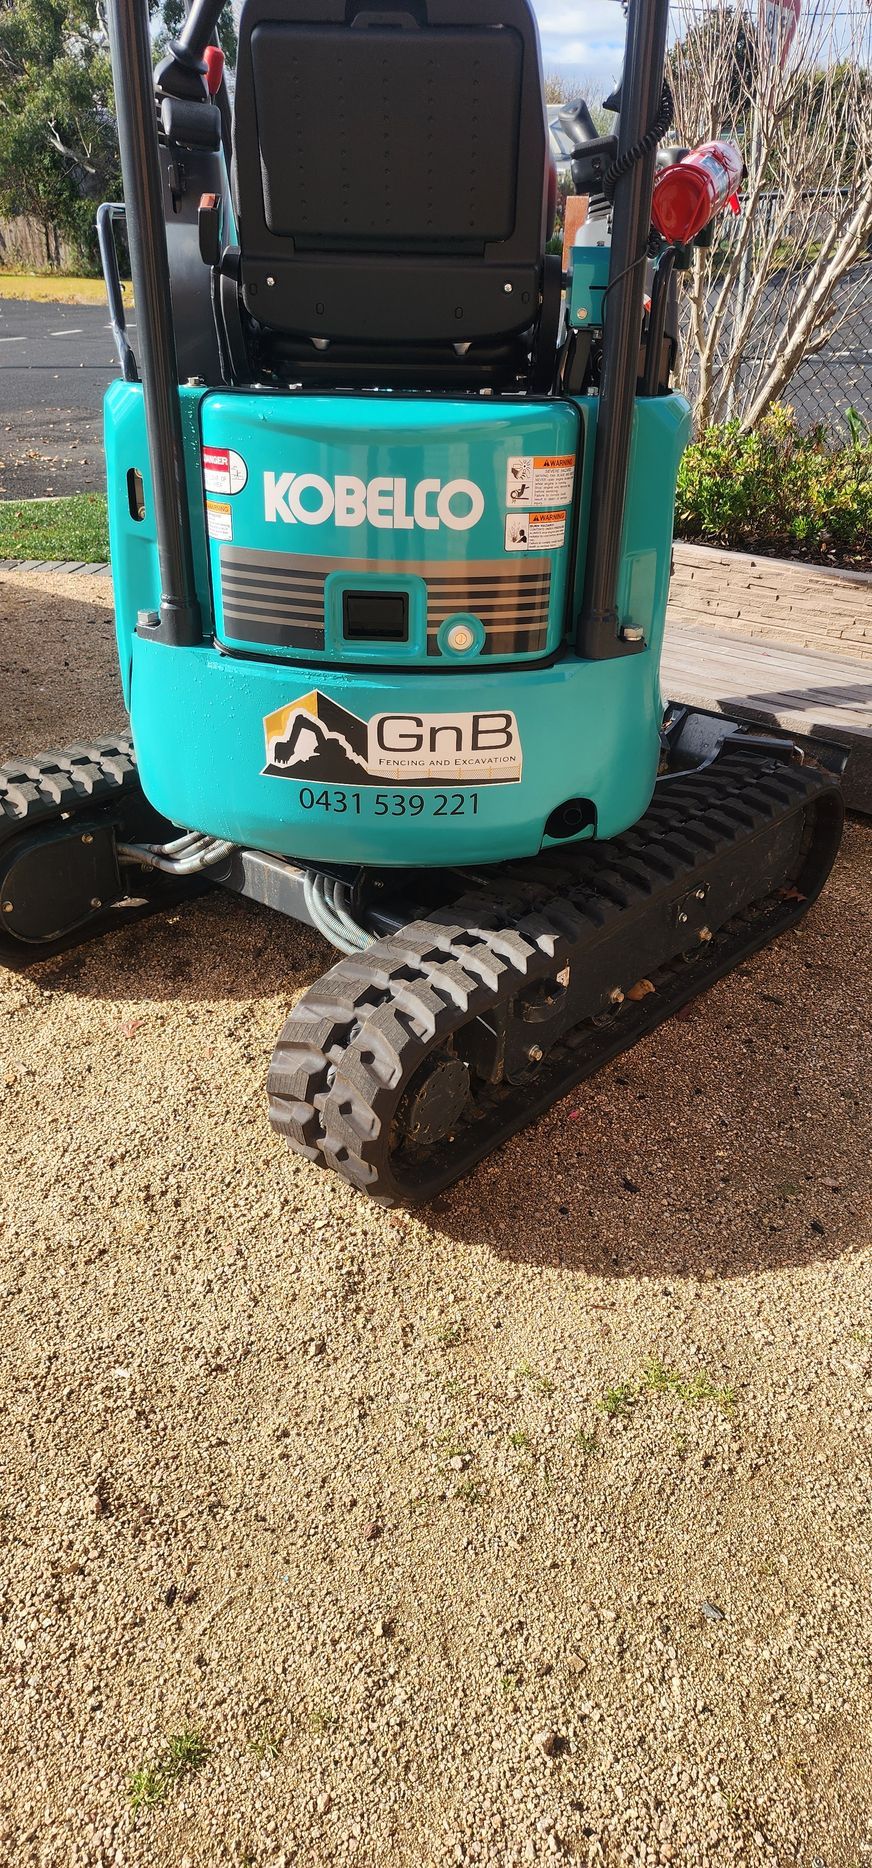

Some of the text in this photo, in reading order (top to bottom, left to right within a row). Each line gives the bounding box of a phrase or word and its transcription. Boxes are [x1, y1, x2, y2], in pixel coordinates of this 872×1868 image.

[204, 453, 228, 466] ANGER
[263, 471, 485, 531] KOBELCO
[540, 512, 564, 521] WARNING
[376, 713, 513, 752] GnB
[299, 787, 479, 817] 0431 539 221
